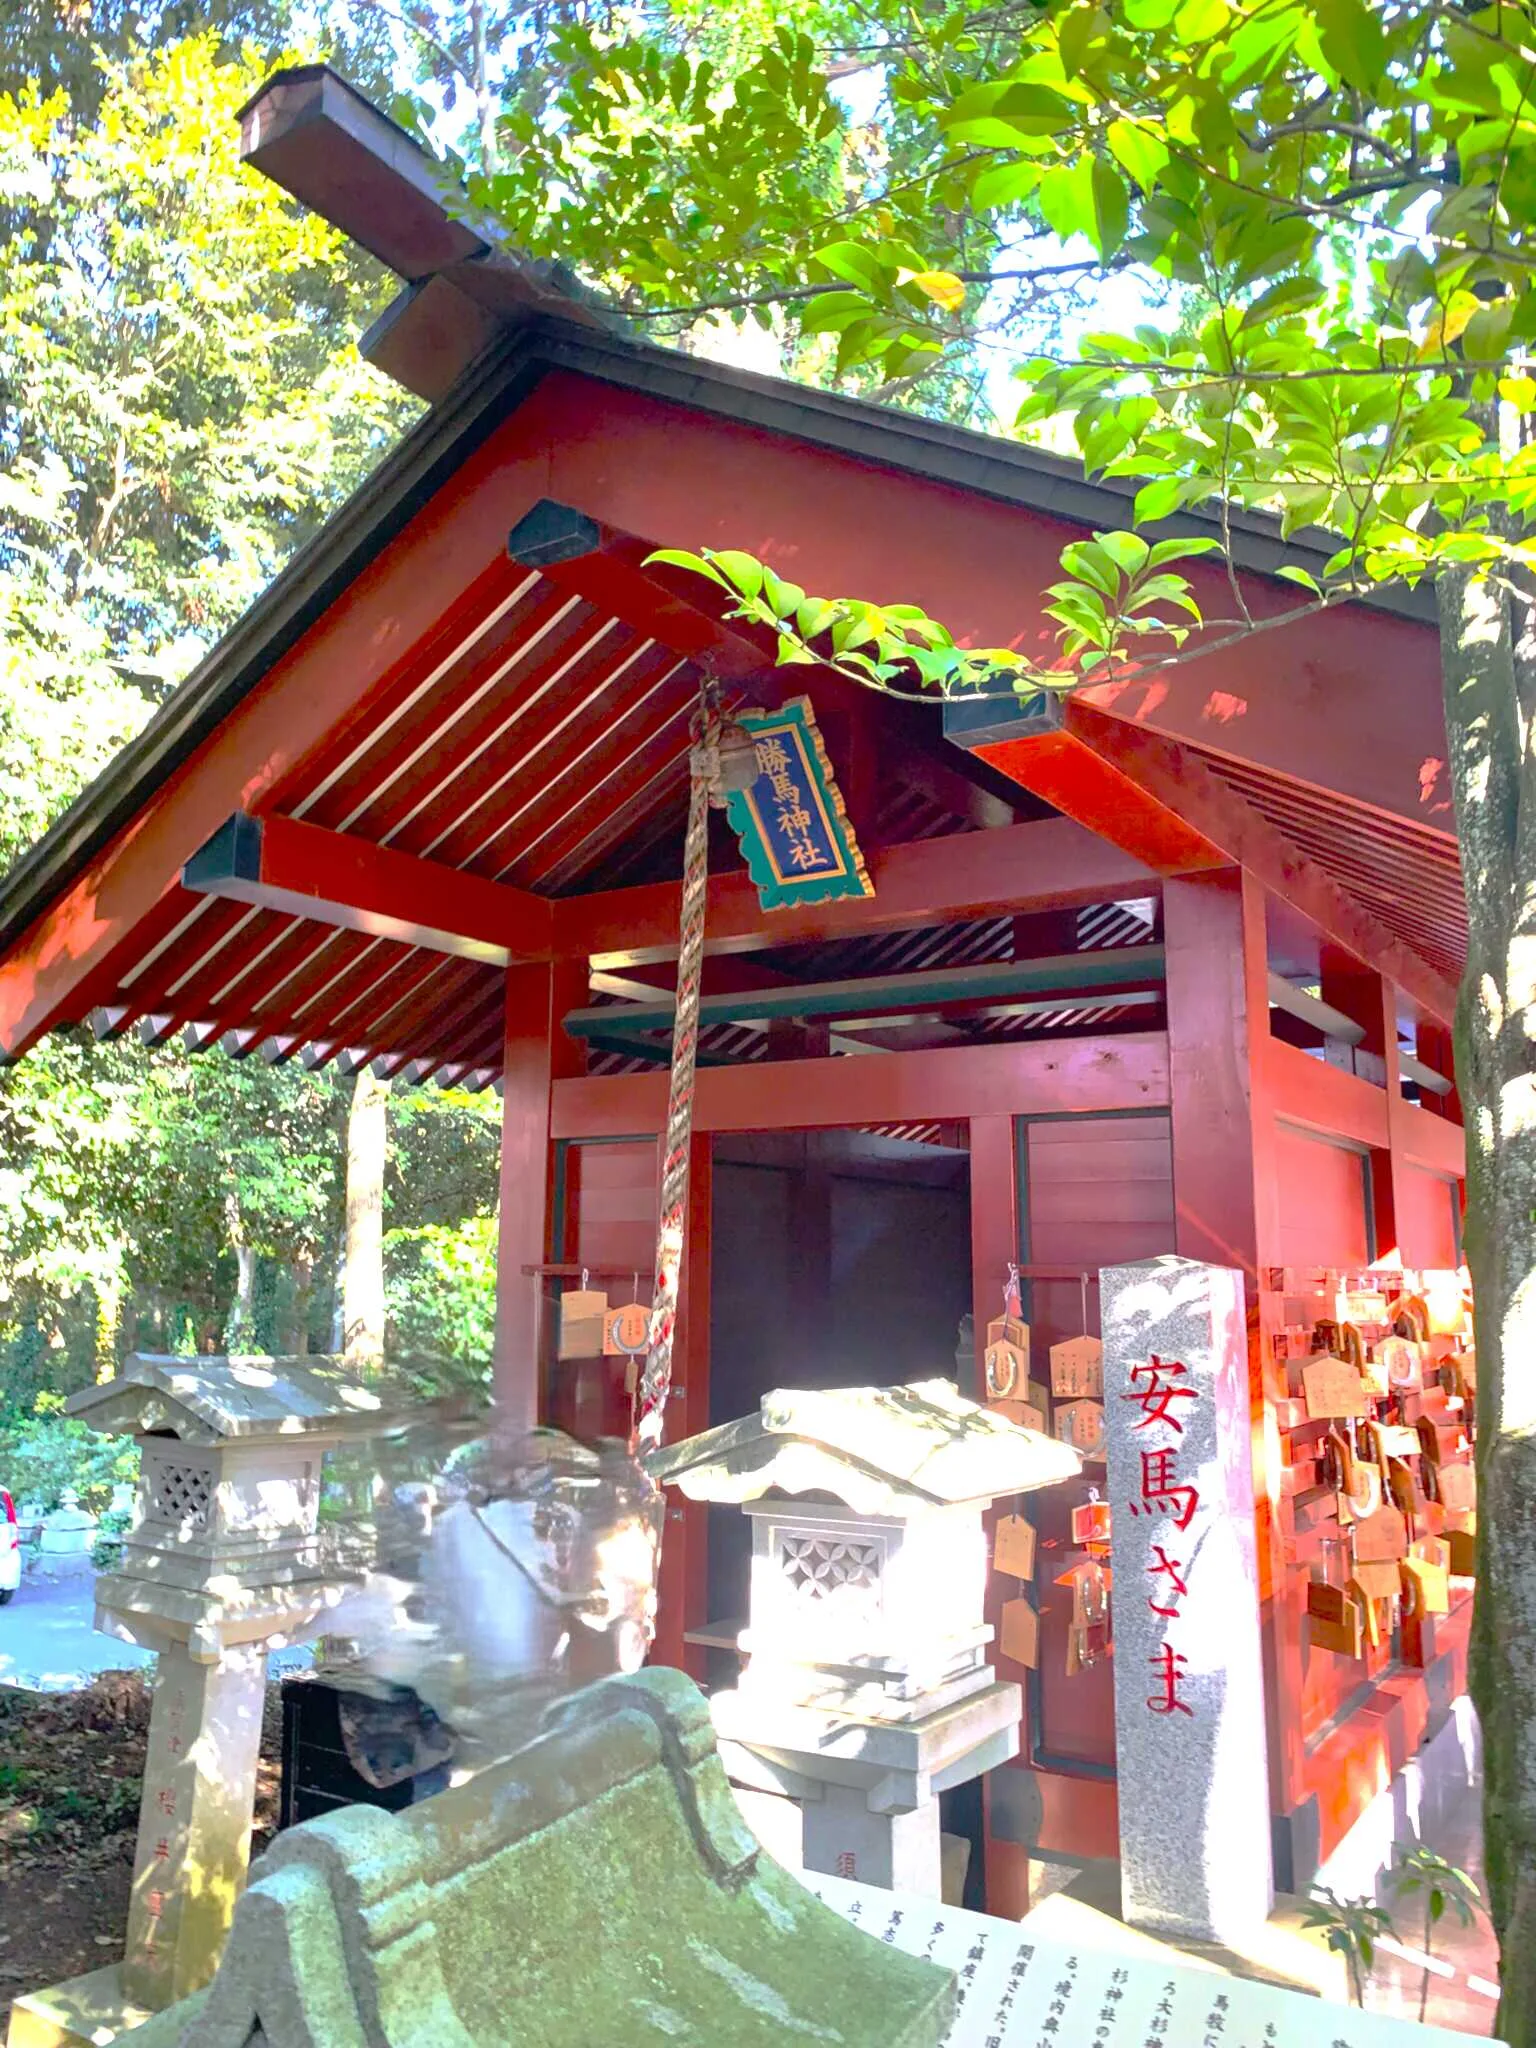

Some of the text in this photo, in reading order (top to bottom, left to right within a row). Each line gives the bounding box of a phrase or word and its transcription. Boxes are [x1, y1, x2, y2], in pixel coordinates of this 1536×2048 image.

[756, 738, 828, 871] 勝馬神社
[1120, 1353, 1200, 1718] 安馬さま
